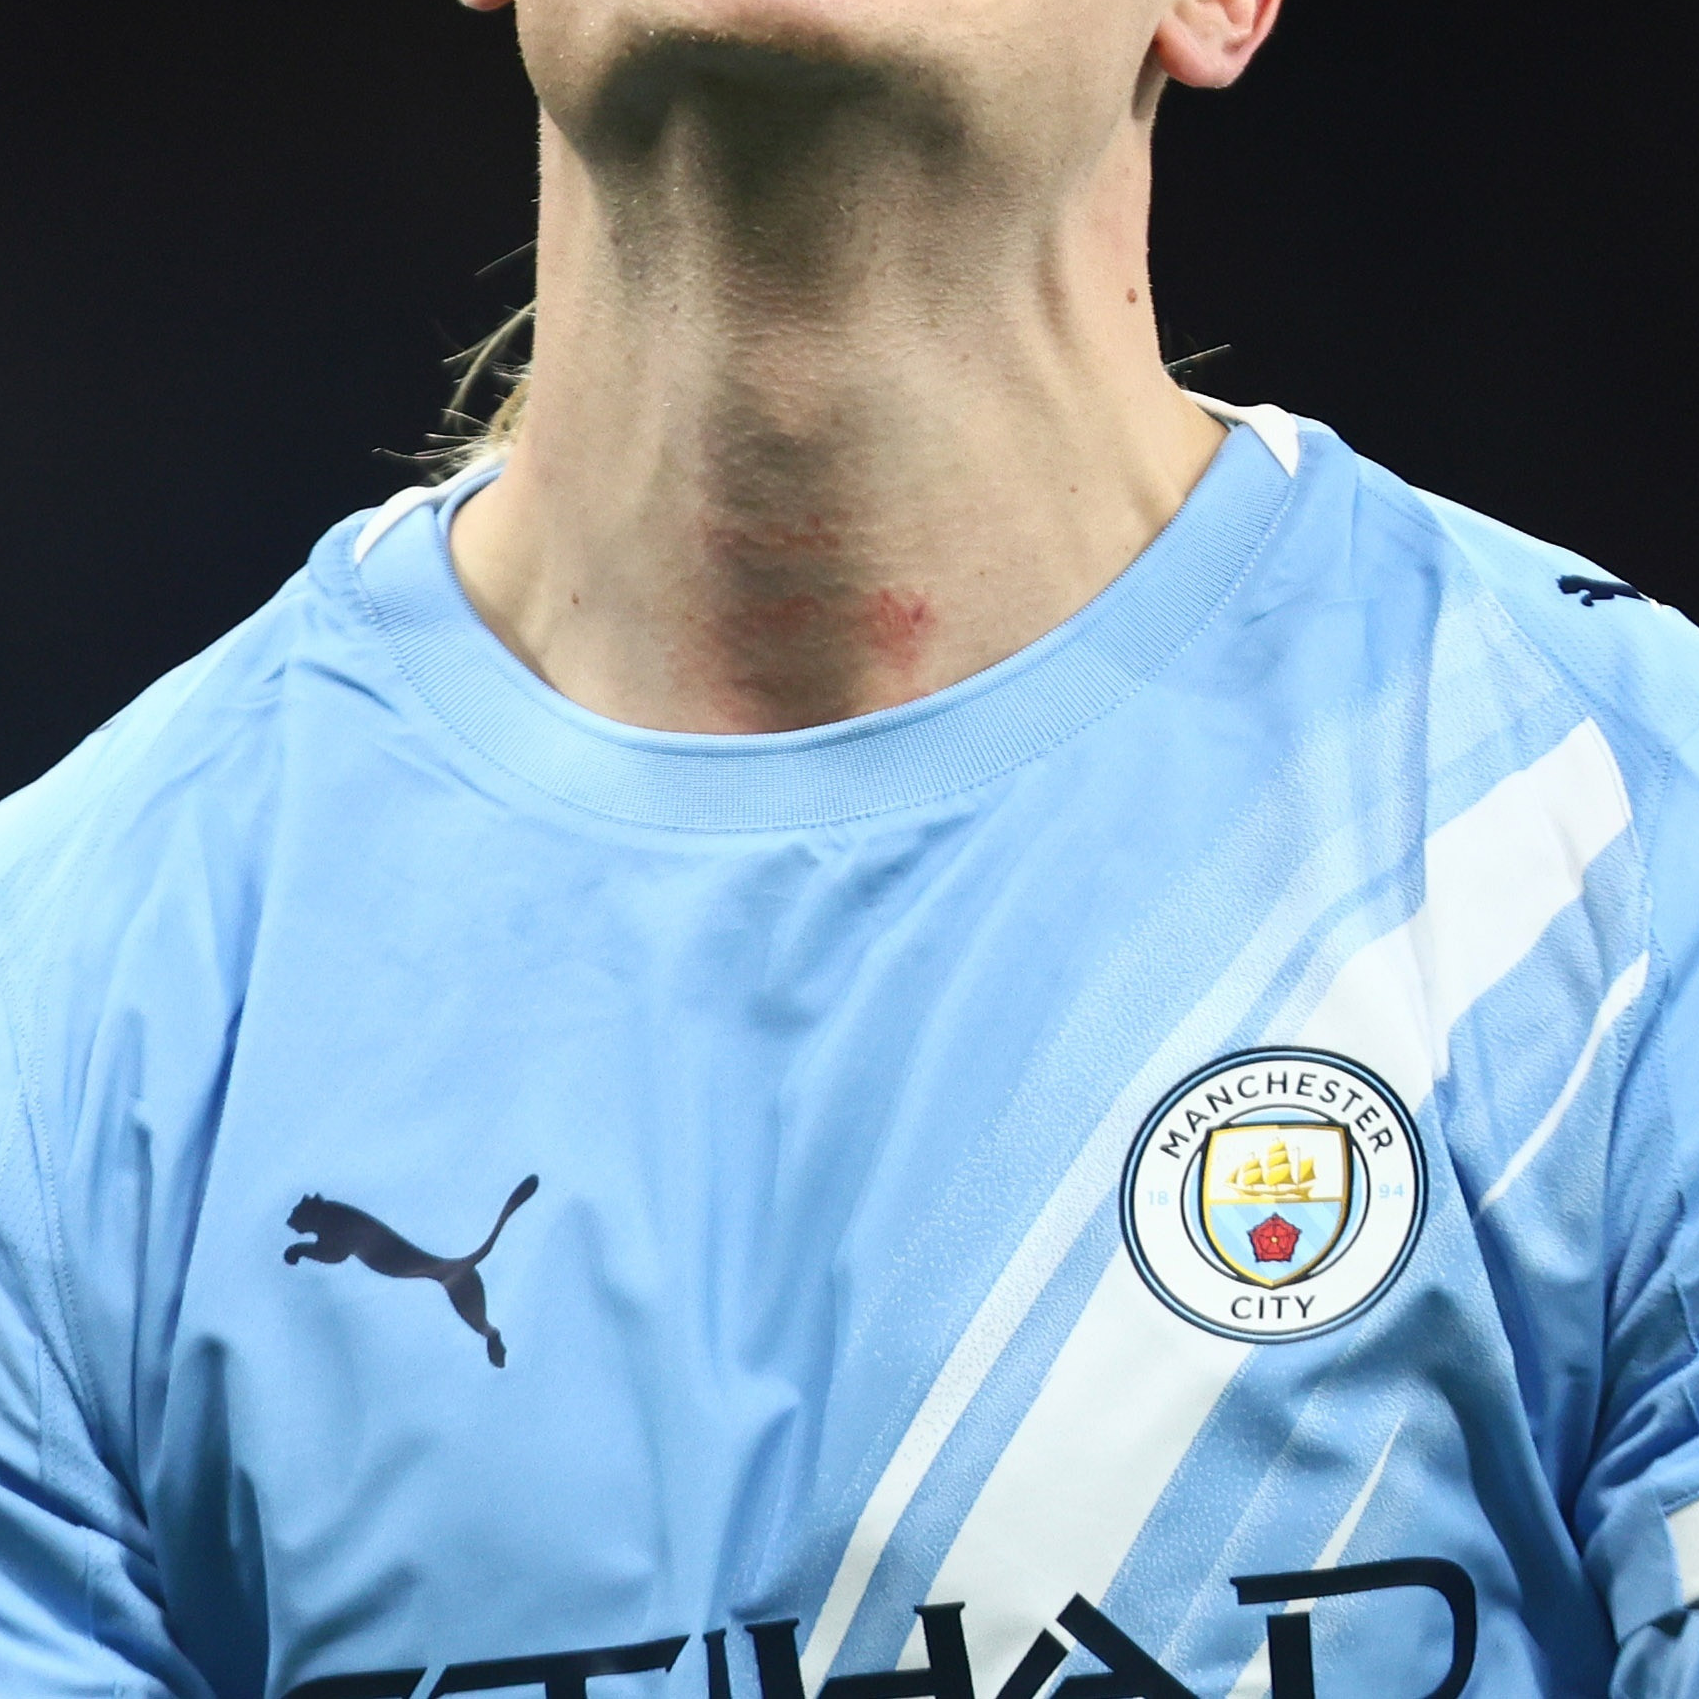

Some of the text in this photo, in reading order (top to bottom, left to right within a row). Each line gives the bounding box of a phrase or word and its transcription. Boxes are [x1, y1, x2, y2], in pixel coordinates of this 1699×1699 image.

[1159, 1070, 1394, 1160] MANCHESTER
[1378, 1183, 1405, 1200] 94
[1230, 1295, 1316, 1320] CITY
